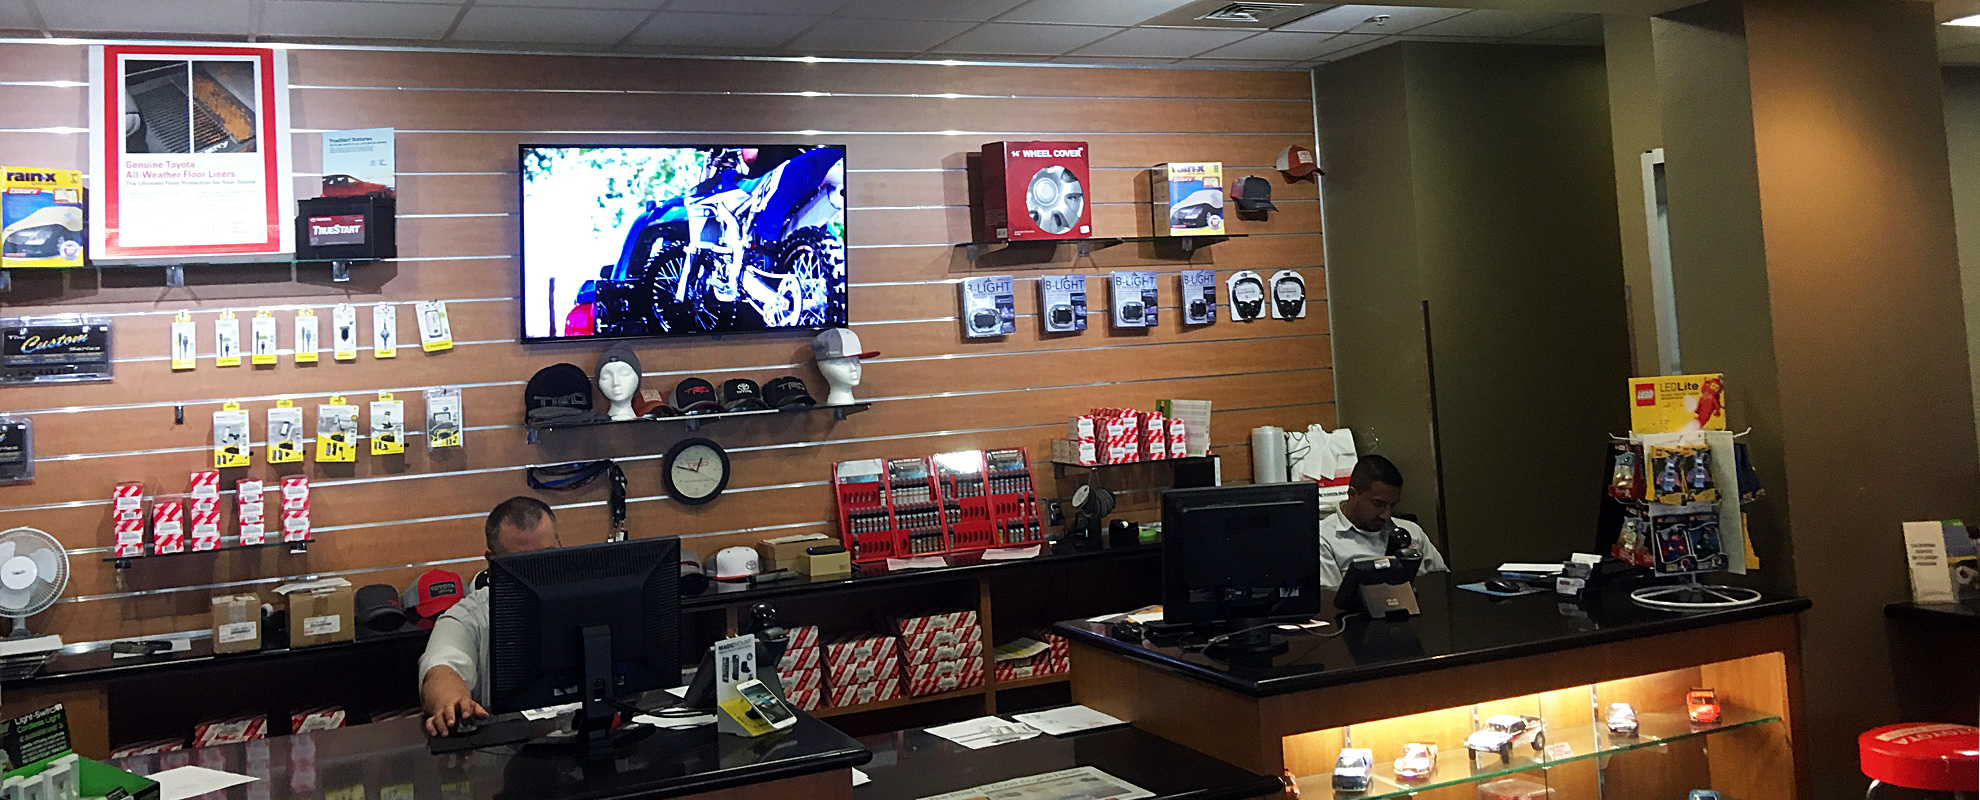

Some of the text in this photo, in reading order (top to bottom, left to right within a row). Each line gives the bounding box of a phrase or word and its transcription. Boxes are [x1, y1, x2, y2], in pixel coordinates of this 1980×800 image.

[1022, 149, 1052, 158] WHEEL
[1053, 149, 1081, 158] COVER
[126, 160, 195, 170] Genuine Toyota
[126, 170, 235, 179] All-Weather Floor Liners
[1115, 274, 1156, 286] B-LIGHT
[1184, 274, 1215, 285] B-LIGHT
[1046, 280, 1085, 290] B-LIGHT
[20, 333, 89, 354] Custom
[684, 386, 710, 394] TRD
[778, 381, 805, 391] TRD
[533, 392, 587, 408] TRD
[430, 583, 455, 592] TOYOTA
